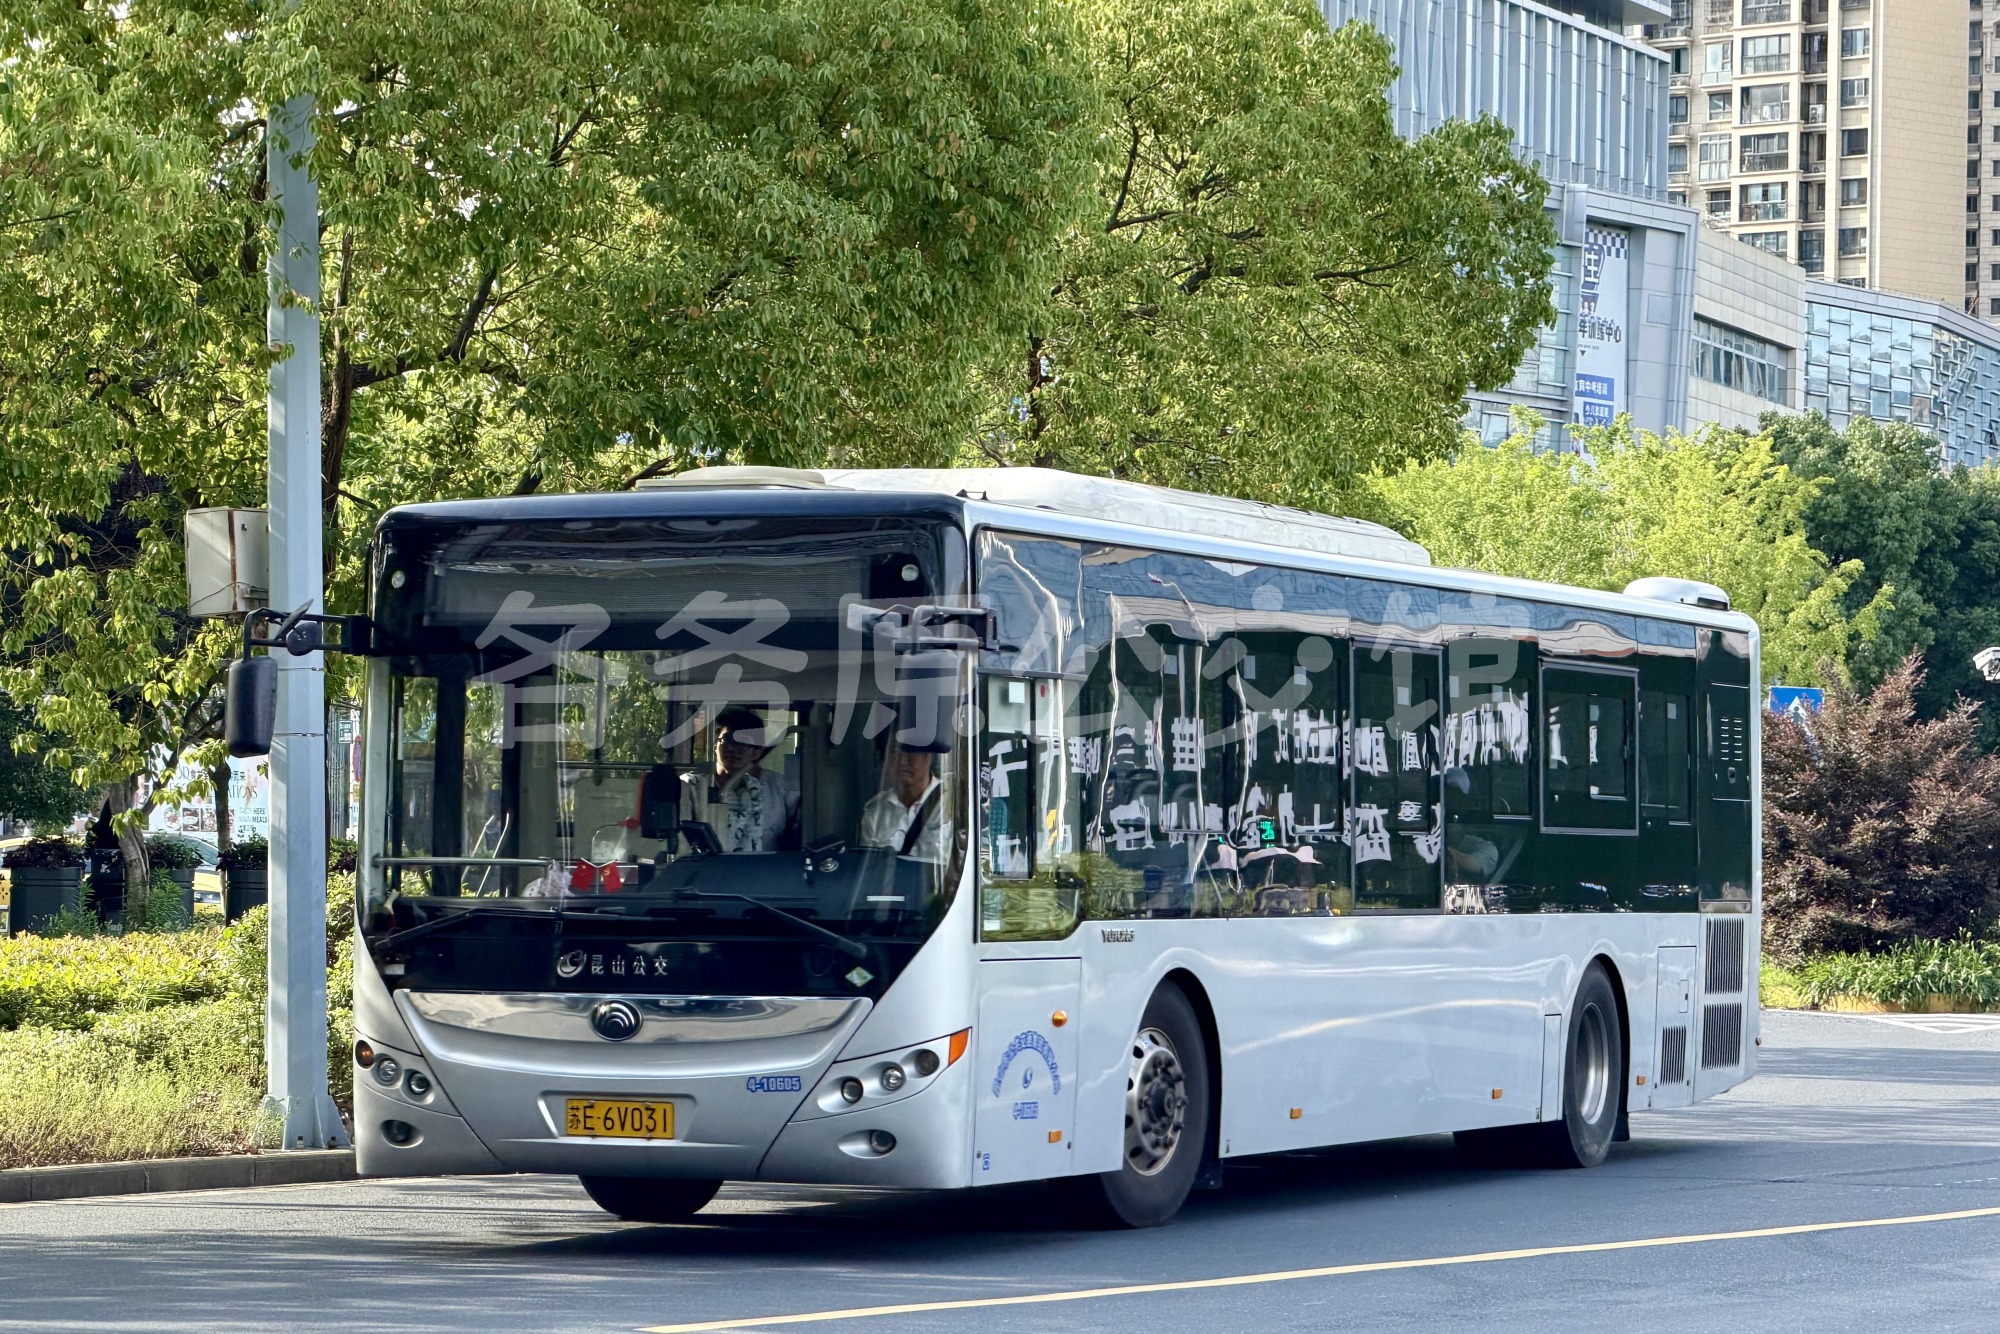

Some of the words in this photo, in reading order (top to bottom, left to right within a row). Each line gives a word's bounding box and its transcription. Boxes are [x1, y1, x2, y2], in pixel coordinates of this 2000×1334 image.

[252, 816, 268, 824] MEALS
[591, 954, 668, 976] 昆山公交
[747, 1076, 801, 1092] 4-10605
